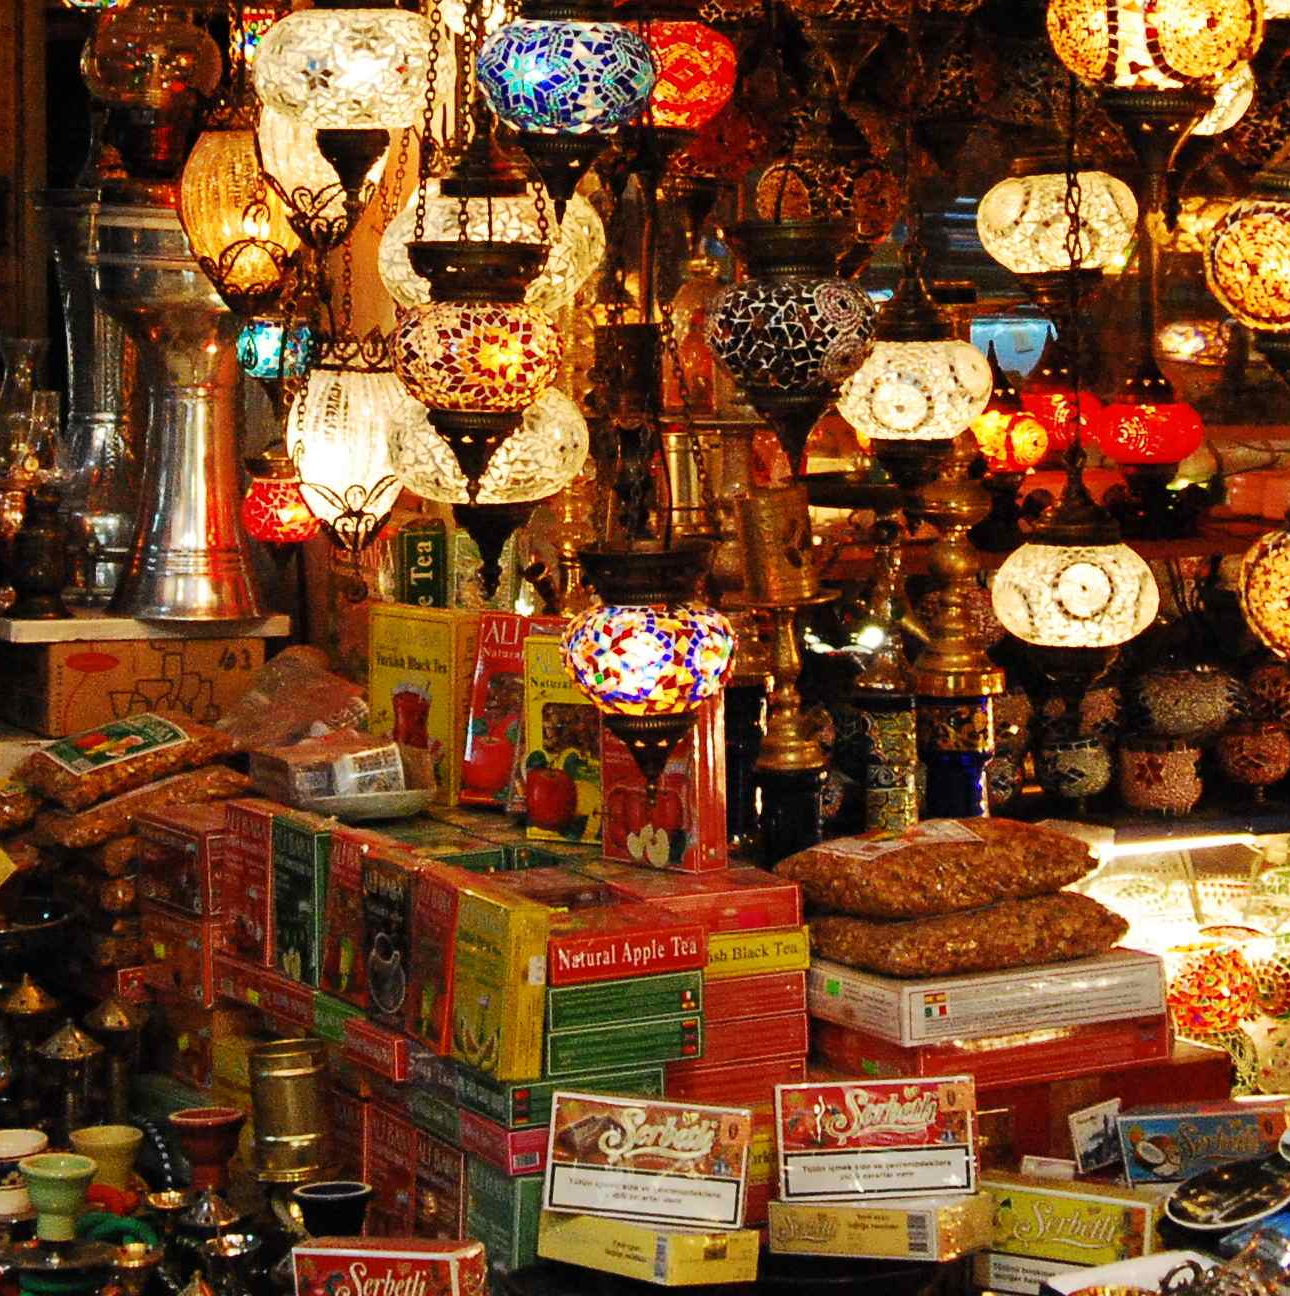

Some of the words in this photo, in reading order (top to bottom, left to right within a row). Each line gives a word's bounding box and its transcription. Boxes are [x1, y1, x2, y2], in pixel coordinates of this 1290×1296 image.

[557, 943, 617, 972] Natural
[621, 938, 666, 967] Apple
[670, 934, 698, 958] Tea
[732, 943, 770, 963] Black
[774, 940, 799, 957] Tea
